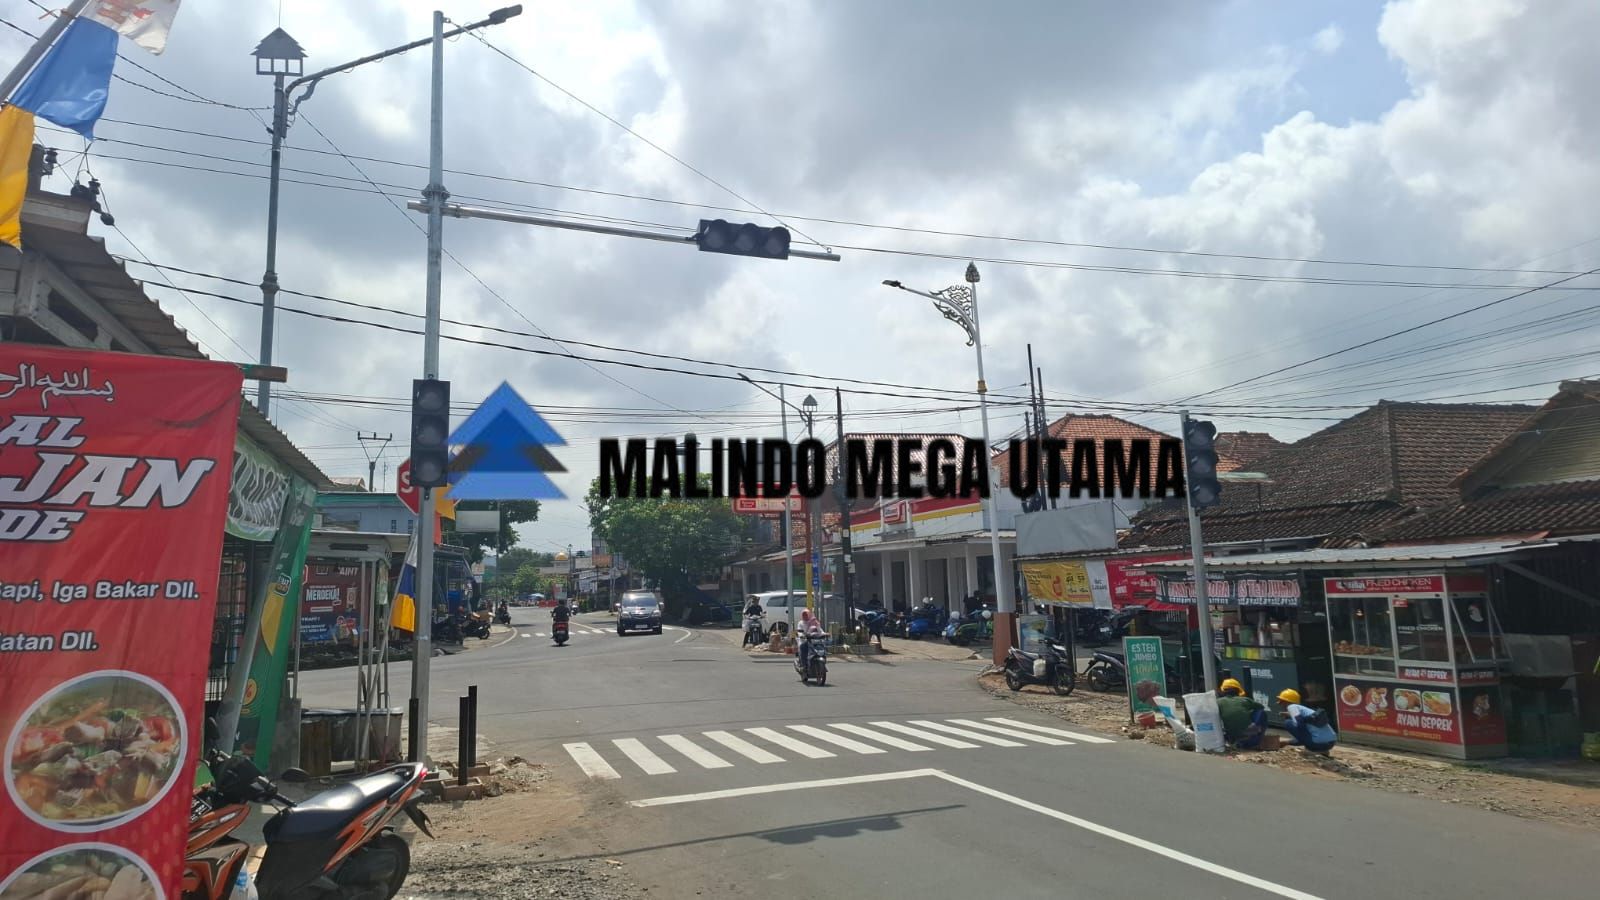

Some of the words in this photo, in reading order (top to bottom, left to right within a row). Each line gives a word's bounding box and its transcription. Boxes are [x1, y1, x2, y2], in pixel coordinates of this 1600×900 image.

[337, 566, 360, 577] AINT
[0, 581, 43, 602] api,
[53, 581, 88, 603] Iga
[95, 581, 159, 599] Bakar
[165, 581, 199, 599] Dll.
[305, 588, 340, 602] MERDEKA!
[0, 632, 54, 650] atan
[61, 631, 98, 650] Dll.
[1131, 643, 1140, 653] ES
[1141, 642, 1157, 653] TEH
[1396, 713, 1420, 728] AYAM
[1421, 716, 1453, 732] GEPREK
